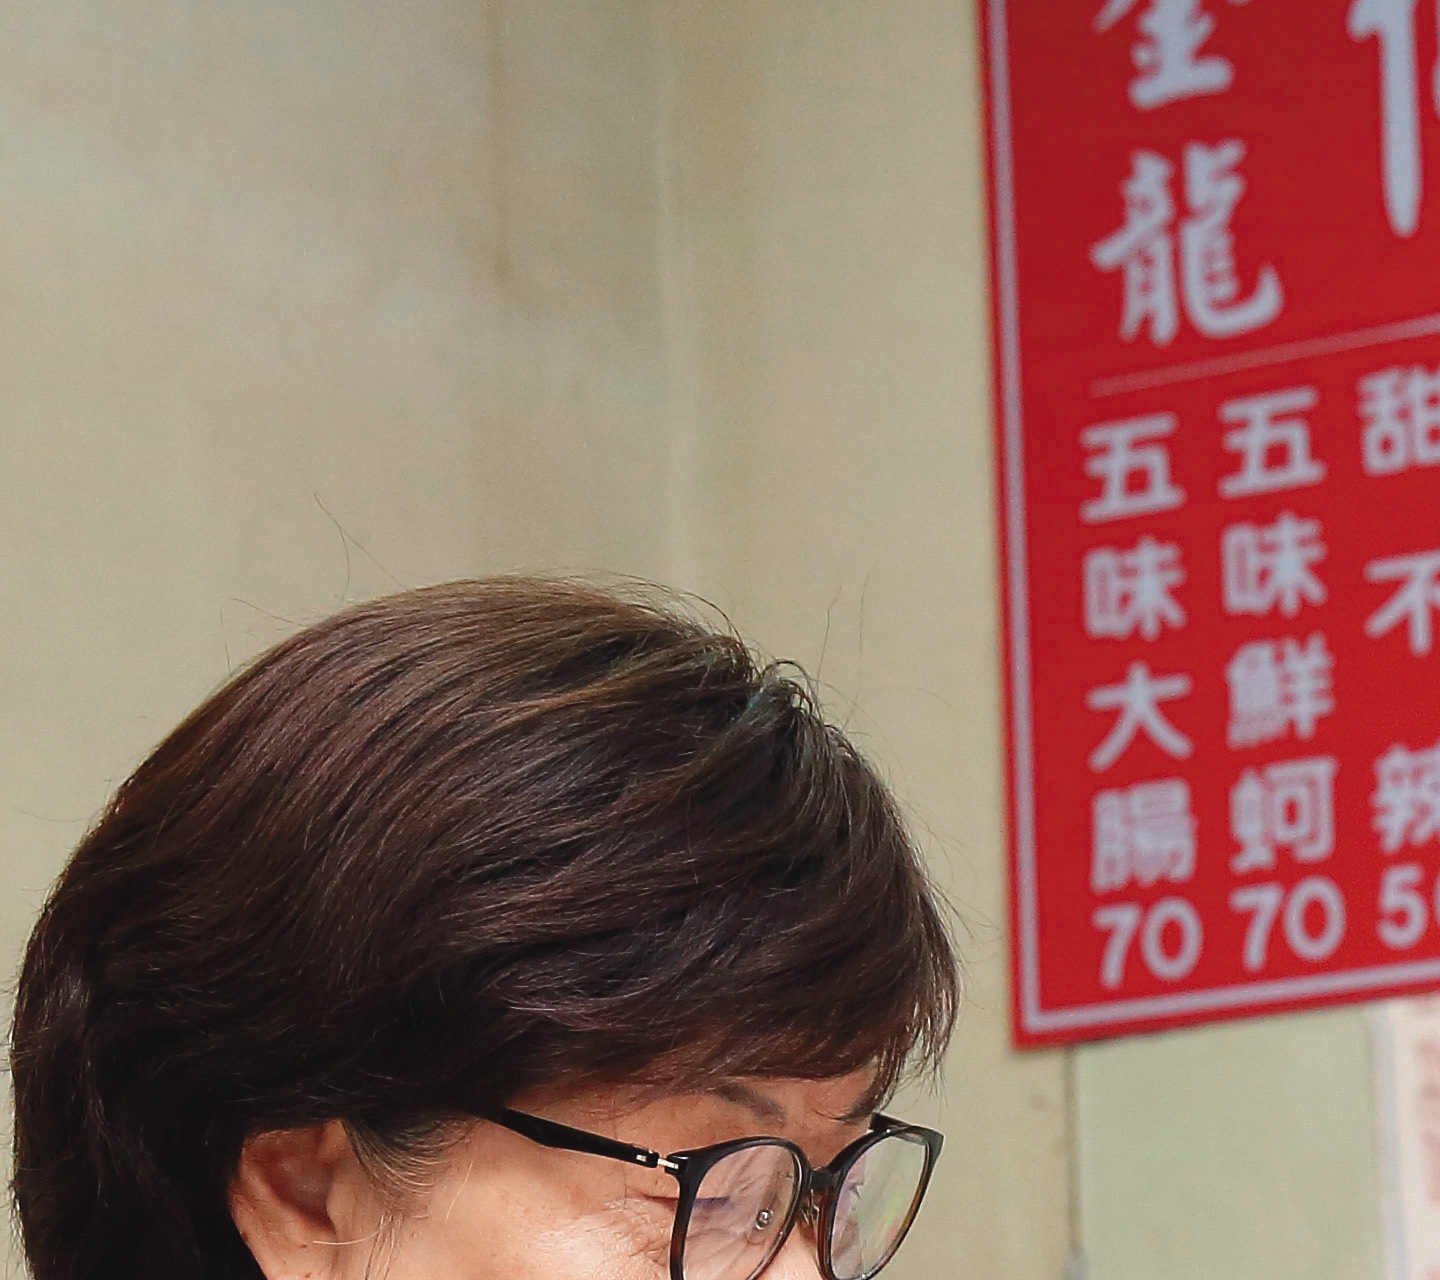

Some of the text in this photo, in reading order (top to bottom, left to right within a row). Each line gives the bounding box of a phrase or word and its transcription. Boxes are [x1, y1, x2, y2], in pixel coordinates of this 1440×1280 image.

[1080, 412, 1200, 893] 五味大腸
[1218, 387, 1338, 875] 五味鮮蚵
[1092, 896, 1205, 990] 70
[1229, 876, 1347, 973] 70
